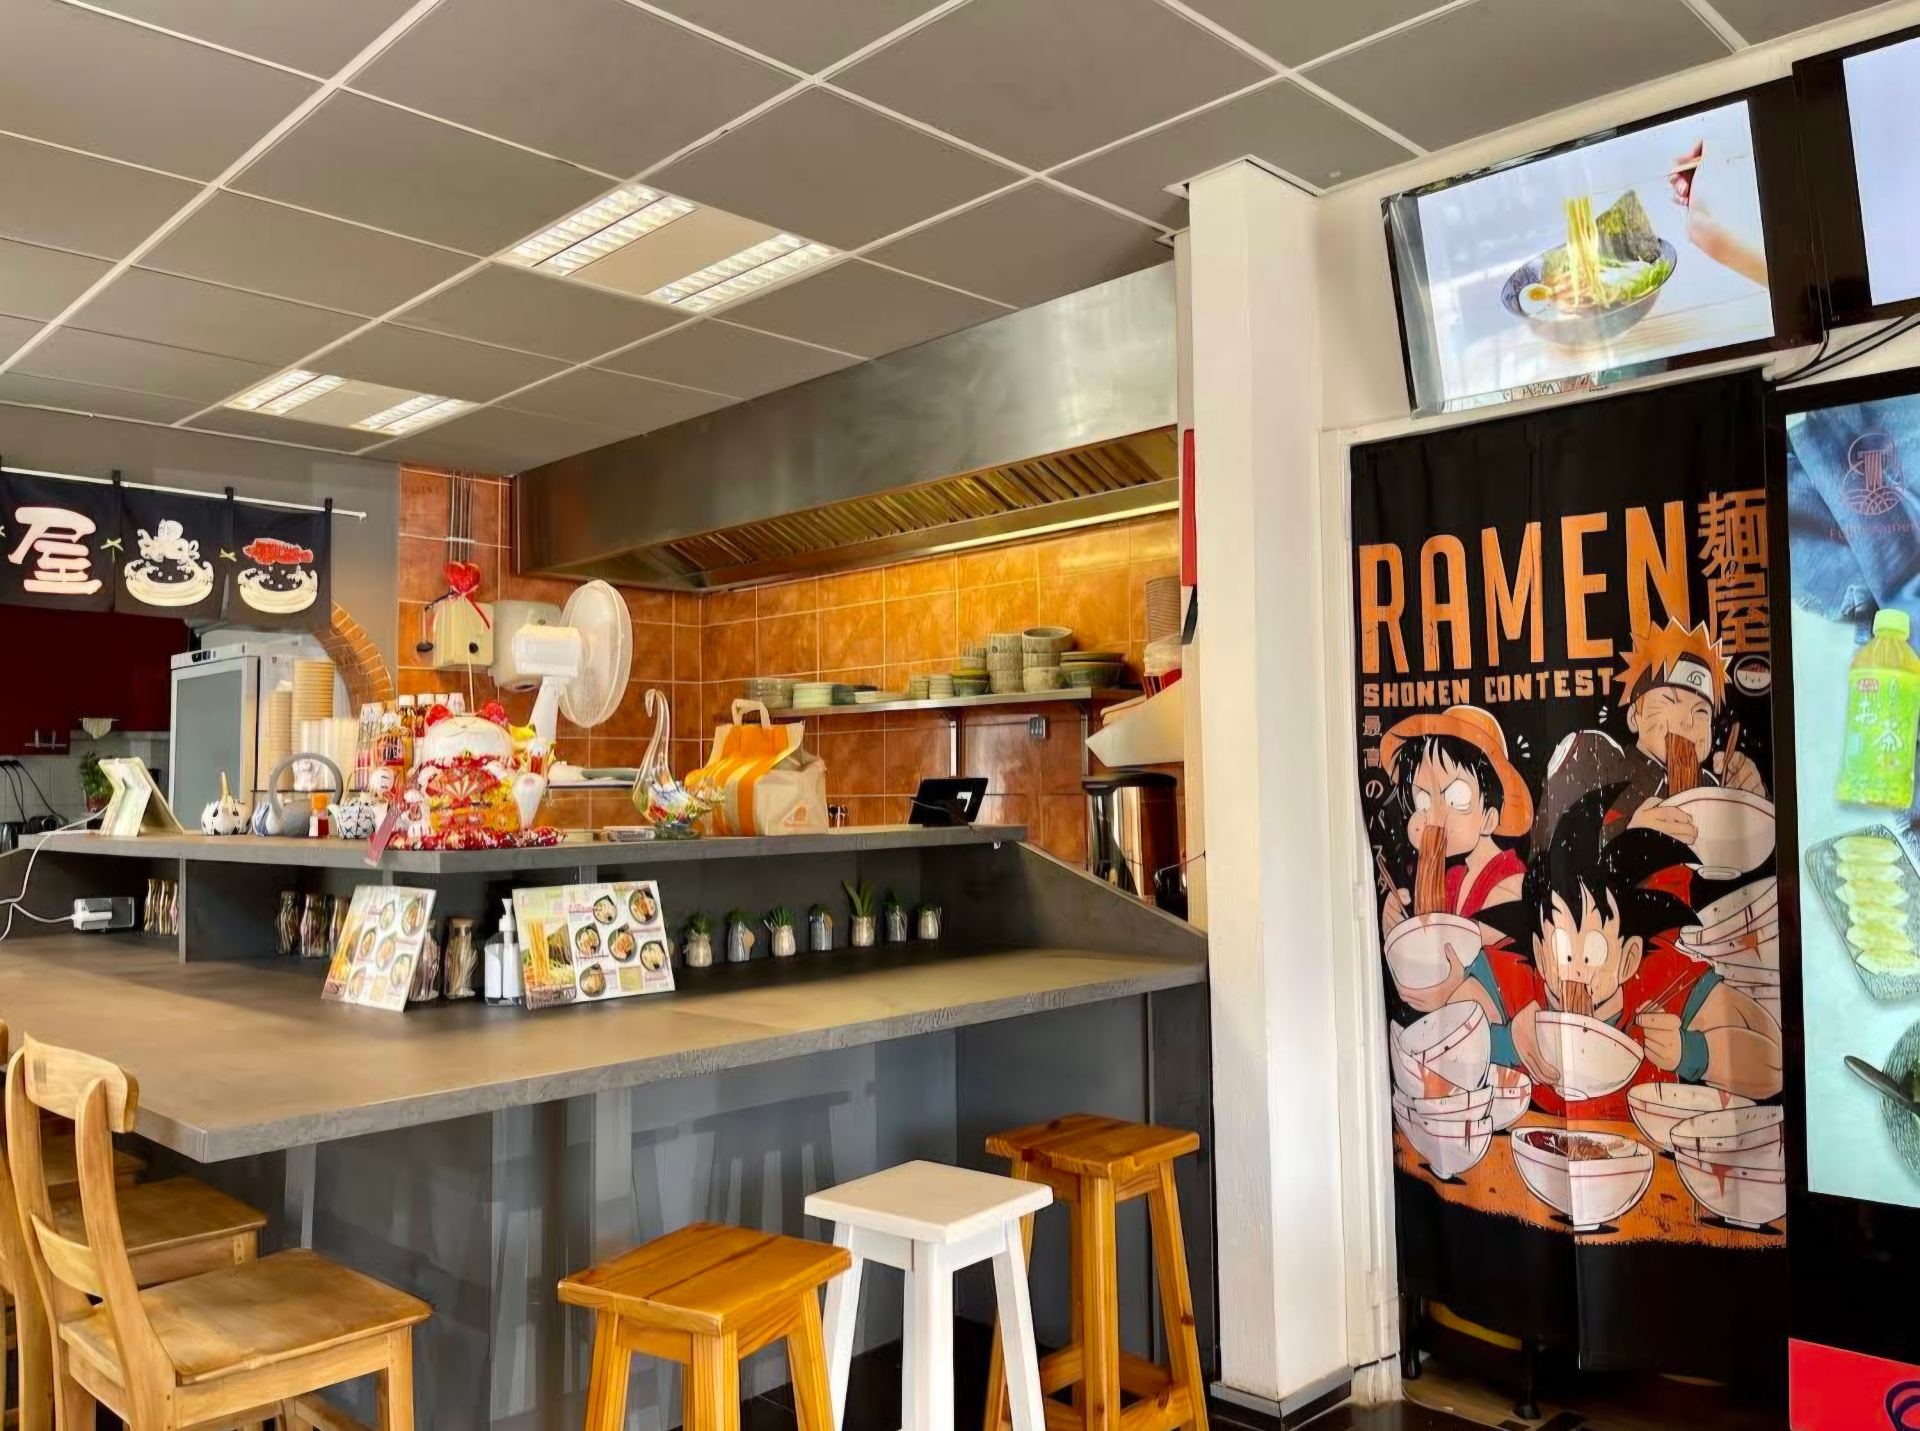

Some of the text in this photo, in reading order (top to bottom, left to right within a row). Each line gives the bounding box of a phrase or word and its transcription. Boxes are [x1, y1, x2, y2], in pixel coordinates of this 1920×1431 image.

[7, 506, 102, 595] 屋
[1359, 500, 1690, 674] RAMEN
[1363, 667, 1613, 707] SHONEN CONTEST
